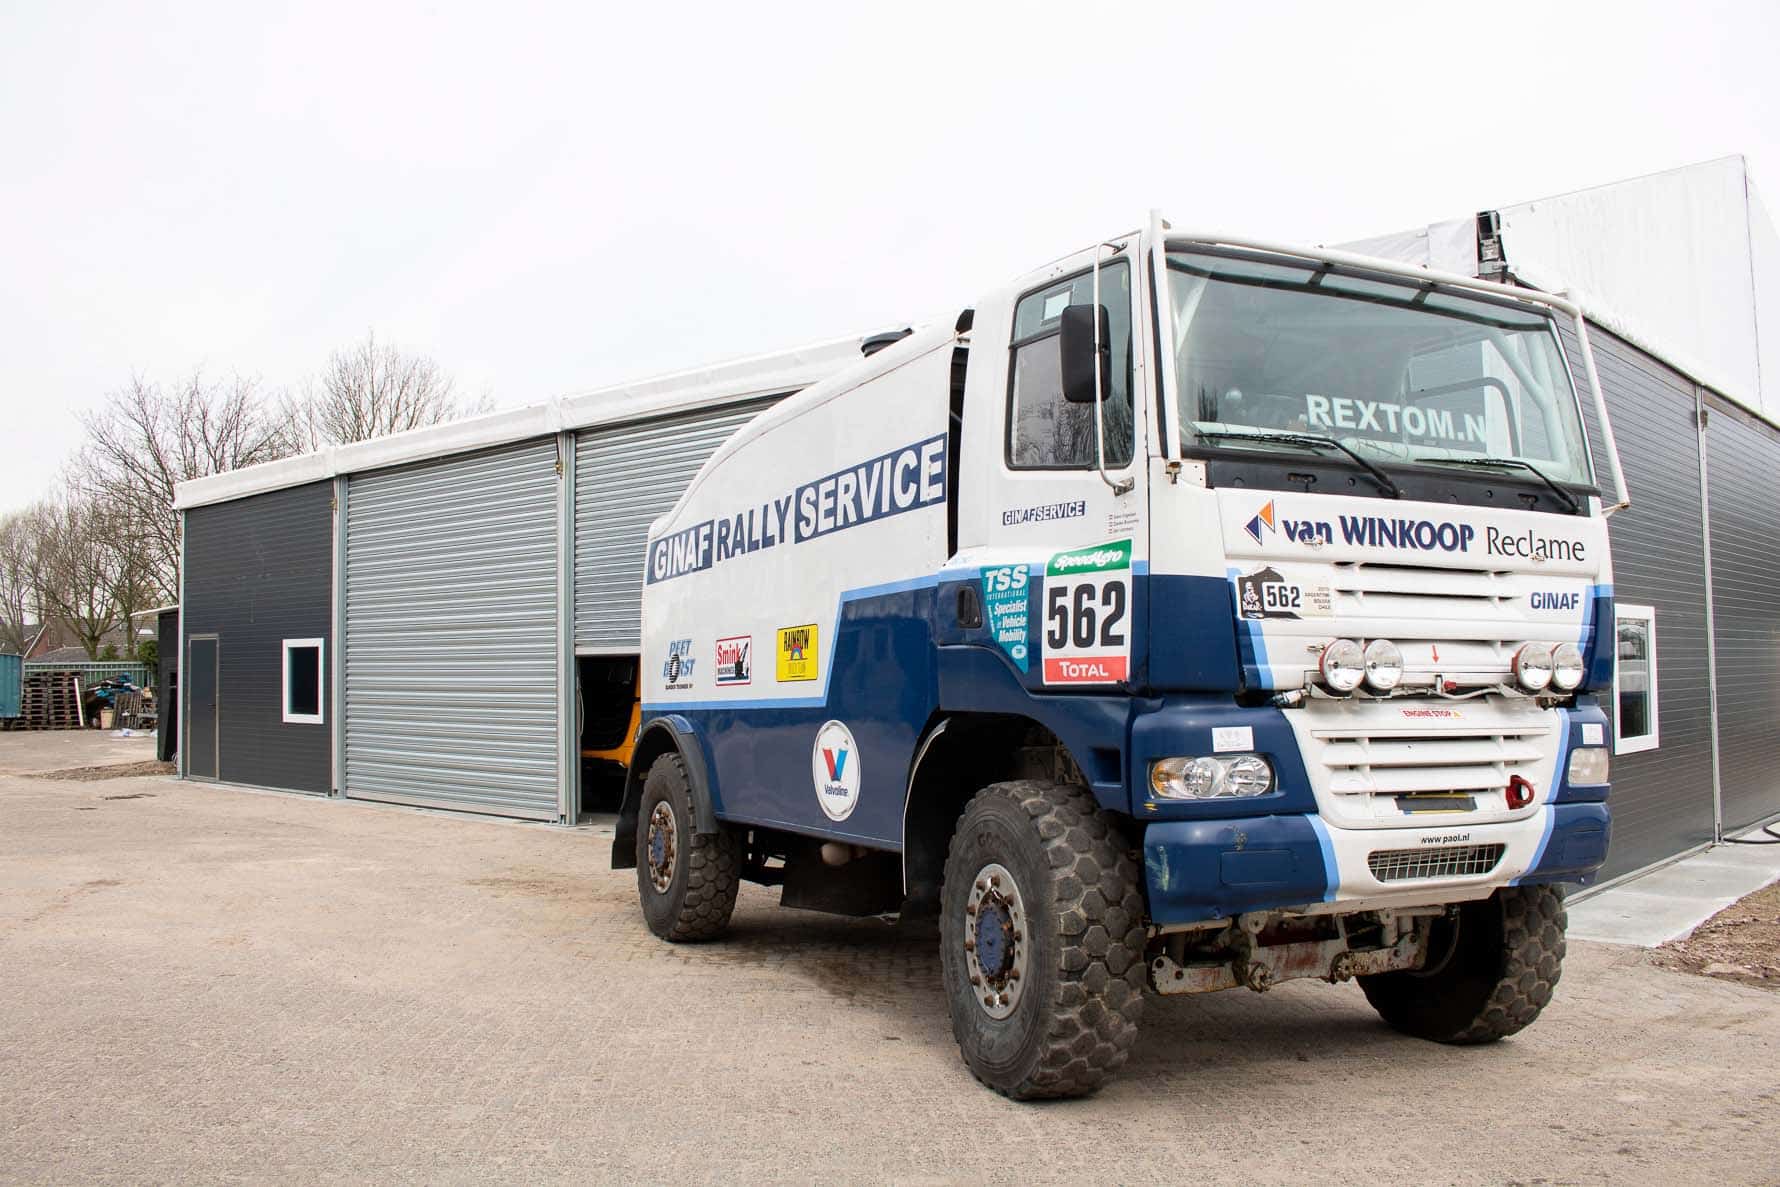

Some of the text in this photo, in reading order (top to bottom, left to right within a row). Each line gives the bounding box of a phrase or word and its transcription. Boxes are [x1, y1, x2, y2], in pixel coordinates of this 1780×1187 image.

[653, 438, 944, 580] GINAF RALLY SERVICE
[1282, 515, 1585, 562] van WINKOOP Reclame
[985, 564, 1028, 593] TSS
[994, 599, 1027, 617] Specialist
[1266, 585, 1301, 608] 562
[1530, 591, 1580, 610] GINAF
[1047, 580, 1127, 650] 562
[999, 628, 1026, 644] Mobility
[717, 643, 741, 666] Smink
[1059, 661, 1109, 678] TOTAL
[824, 784, 849, 798] Valvoline
